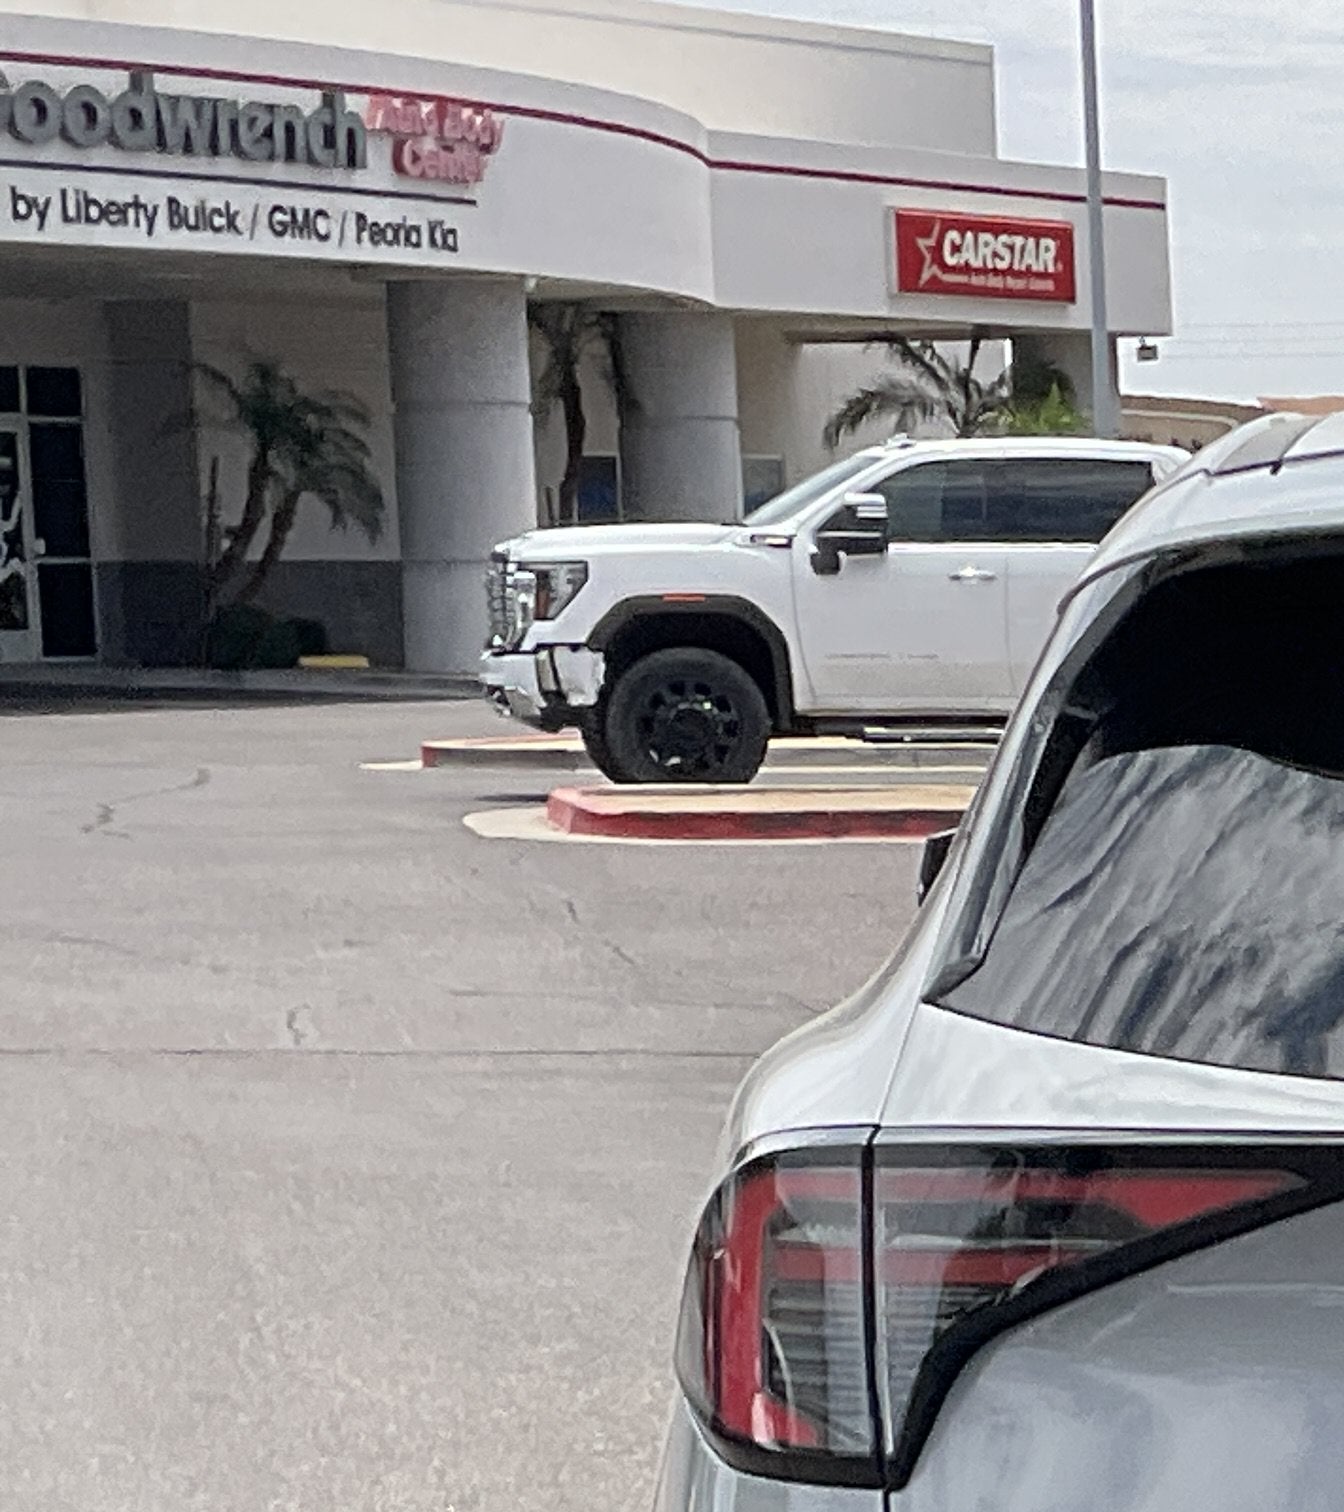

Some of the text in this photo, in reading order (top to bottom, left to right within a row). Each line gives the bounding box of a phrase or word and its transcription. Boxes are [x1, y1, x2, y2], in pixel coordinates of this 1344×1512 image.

[0, 68, 368, 169] oodwrench
[10, 185, 51, 231] by
[60, 187, 159, 236] Liberty
[167, 195, 243, 235] Buick
[268, 204, 331, 242] GMC
[942, 229, 1056, 272] CARSTAR
